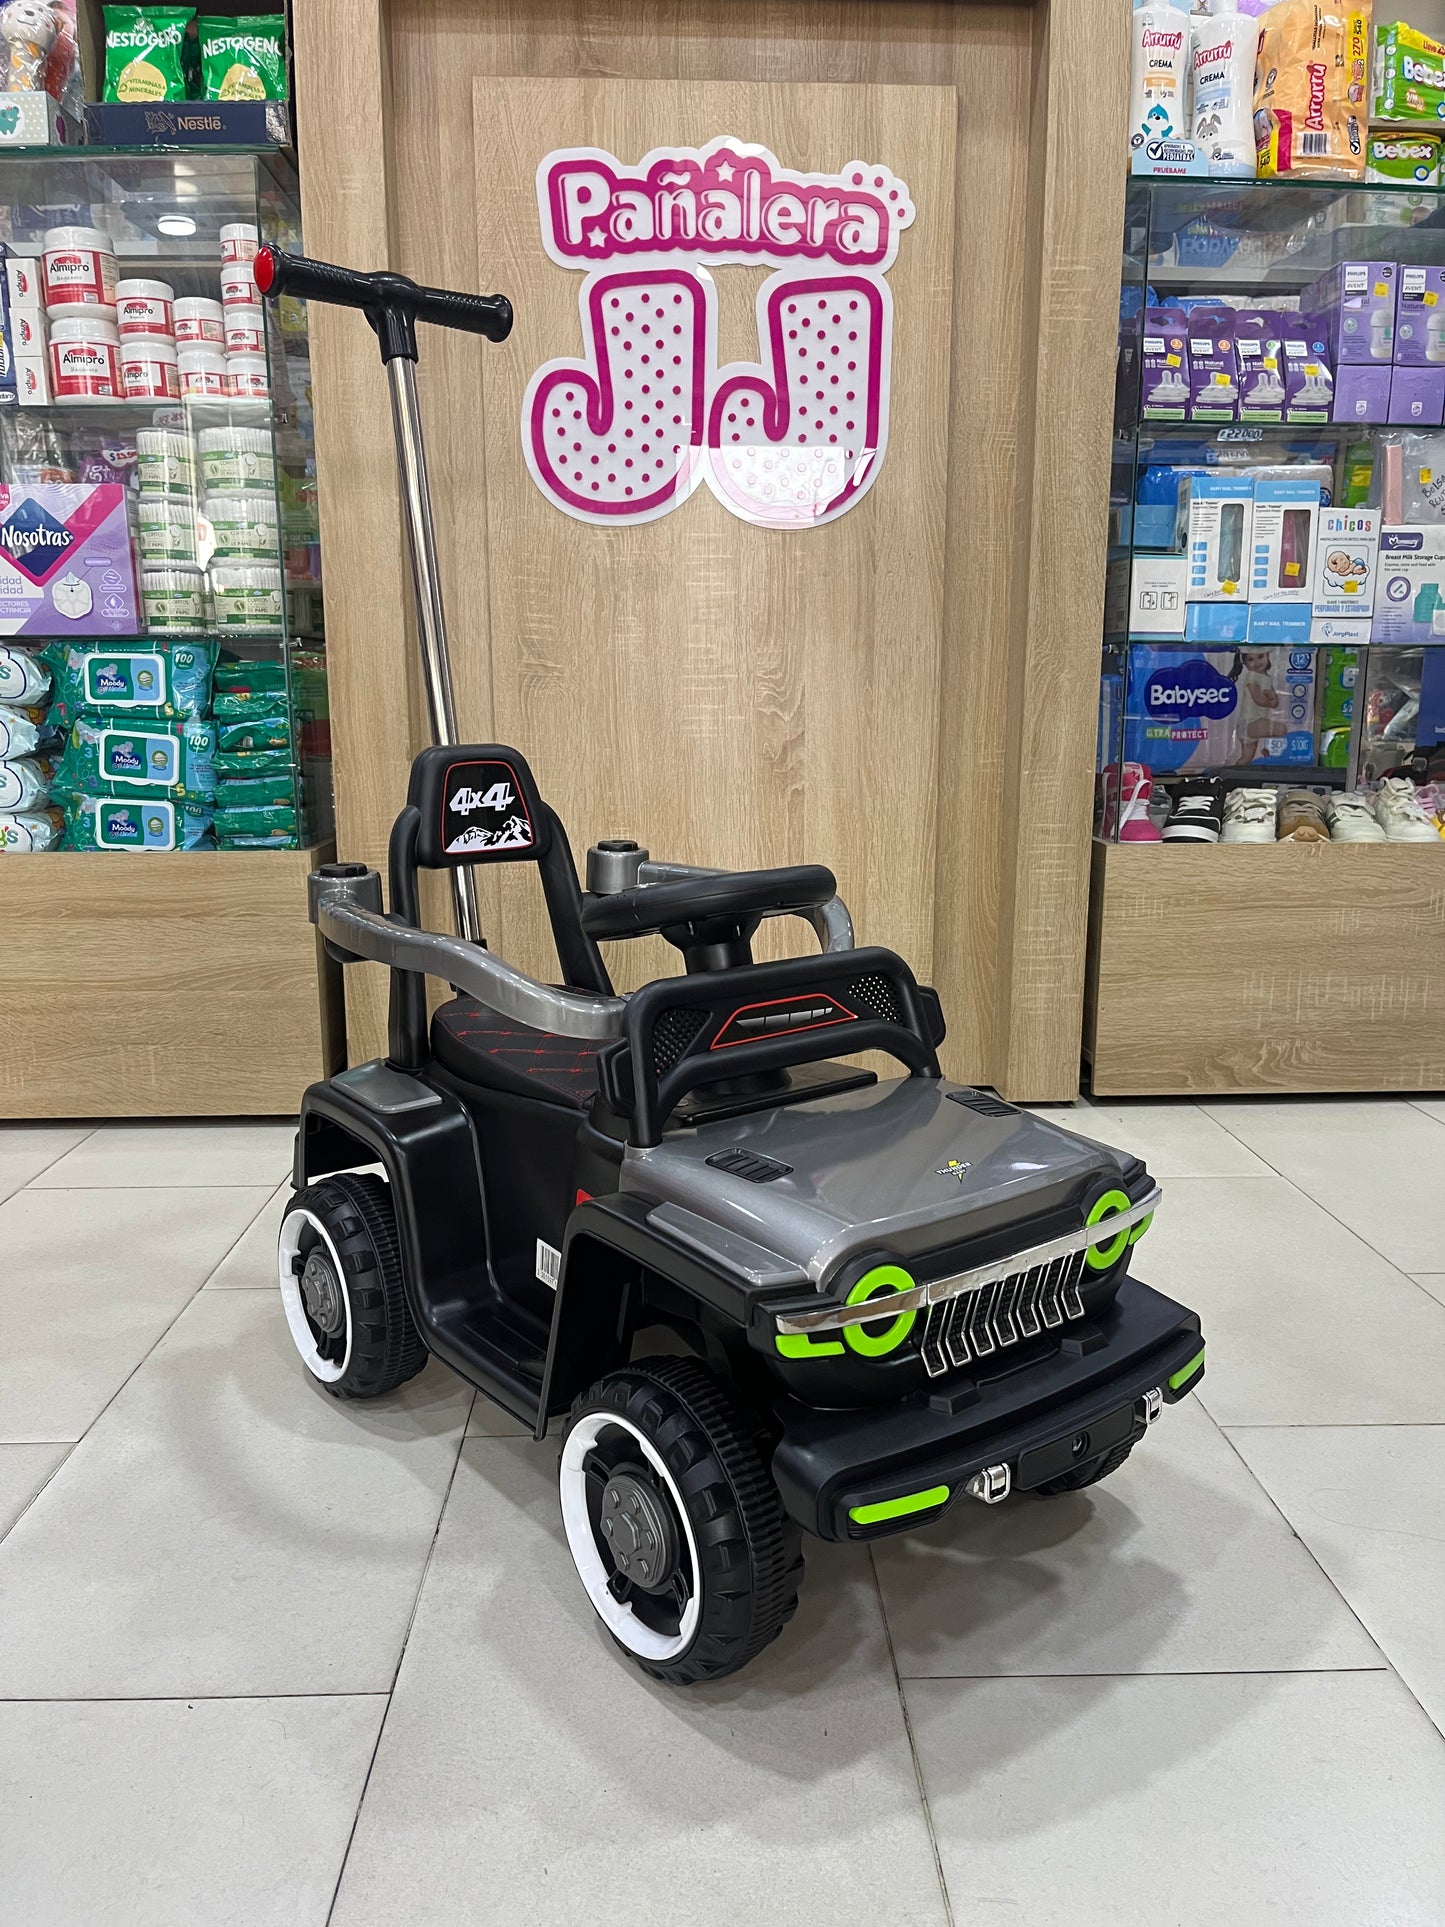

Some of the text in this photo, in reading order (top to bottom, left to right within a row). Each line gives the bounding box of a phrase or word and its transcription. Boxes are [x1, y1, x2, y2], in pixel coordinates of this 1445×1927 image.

[1142, 28, 1183, 50] Arrurrú
[1352, 37, 1361, 56] 270
[1149, 59, 1173, 69] CREMA
[1193, 40, 1232, 70] Arrurrú
[1200, 72, 1225, 85] CREMA
[1305, 63, 1327, 131] Arrurrú
[1371, 141, 1433, 161] Bebex
[558, 166, 880, 254] Pañalera
[50, 262, 89, 273] Almipro
[16, 269, 24, 298] Almipro
[123, 305, 154, 315] Almipro
[19, 318, 27, 346] Almipro
[62, 354, 105, 365] Almipro
[25, 367, 33, 395] Almipro
[1327, 515, 1372, 532] chicos
[1, 524, 70, 547] Nosotras
[175, 652, 193, 664] 100
[100, 678, 125, 688] Moody
[1151, 685, 1230, 707] Babysec
[190, 735, 209, 747] 100
[1171, 729, 1208, 740] PROTECT
[115, 755, 140, 766] Moody
[449, 782, 516, 816] 4x4
[111, 823, 137, 833] Moody
